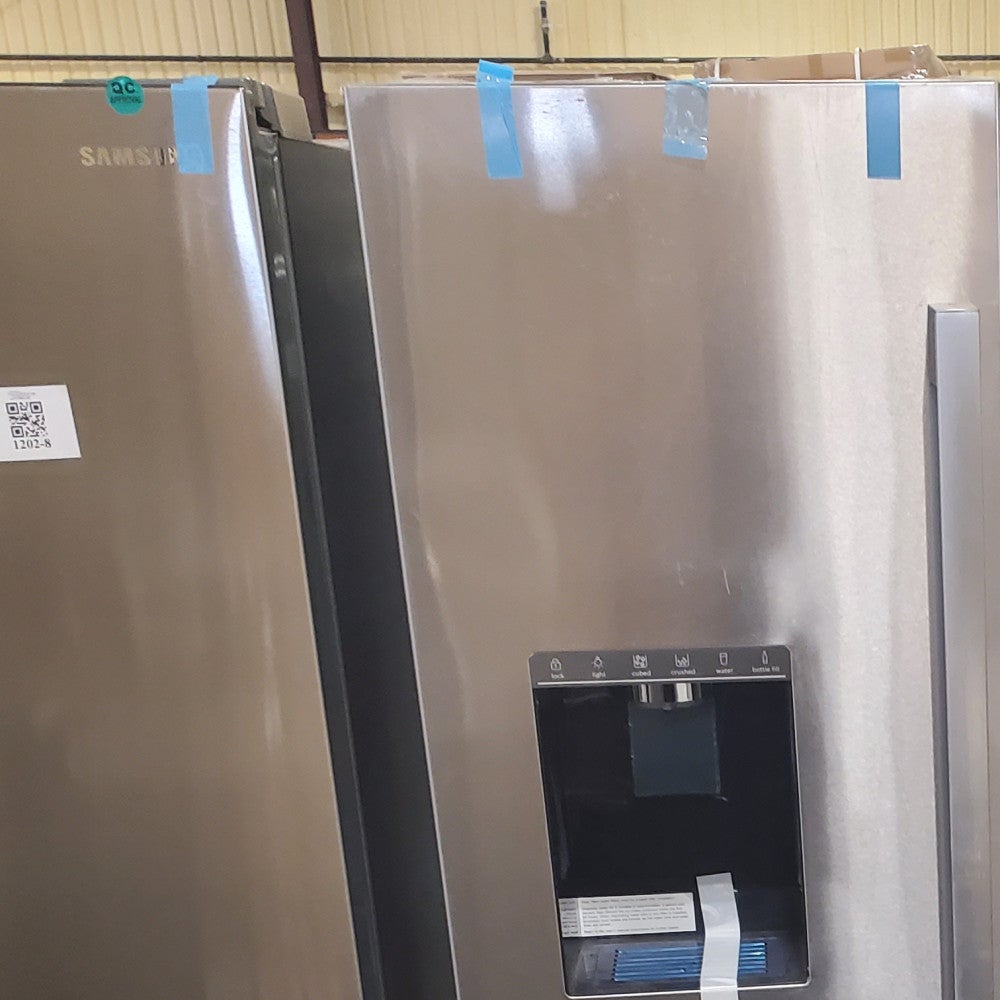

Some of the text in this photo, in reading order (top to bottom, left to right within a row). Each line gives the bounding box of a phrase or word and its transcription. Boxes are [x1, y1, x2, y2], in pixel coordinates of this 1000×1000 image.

[111, 81, 135, 95] QC
[80, 146, 177, 167] SAMSUN
[13, 438, 52, 450] 1202-8
[670, 668, 696, 676] crushed
